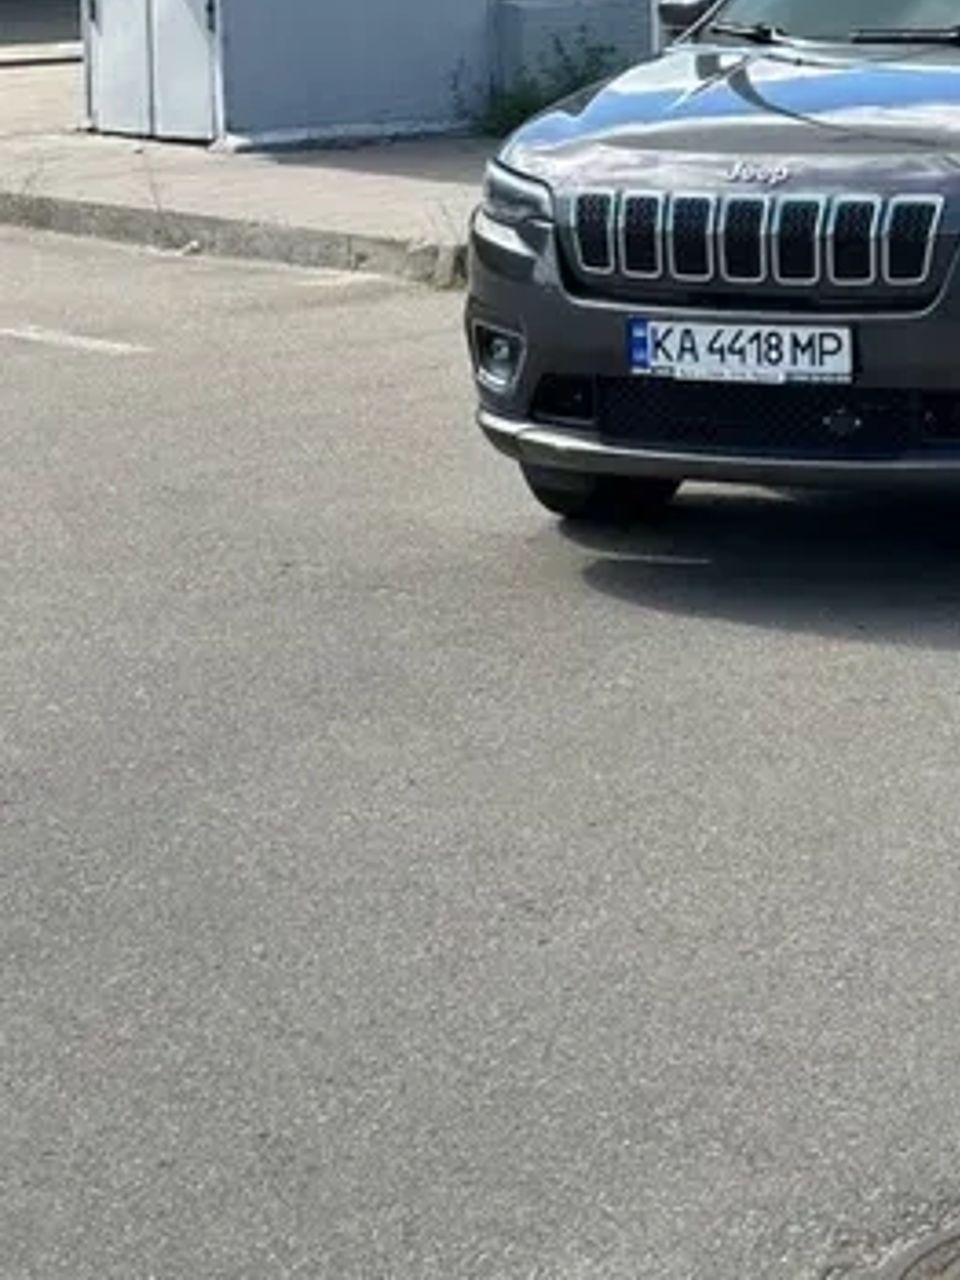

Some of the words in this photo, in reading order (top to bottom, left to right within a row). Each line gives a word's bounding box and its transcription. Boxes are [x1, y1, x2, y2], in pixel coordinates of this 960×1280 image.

[722, 160, 788, 185] Jeep
[652, 326, 700, 363] KA
[707, 328, 784, 367] 4418
[790, 331, 843, 367] MP
